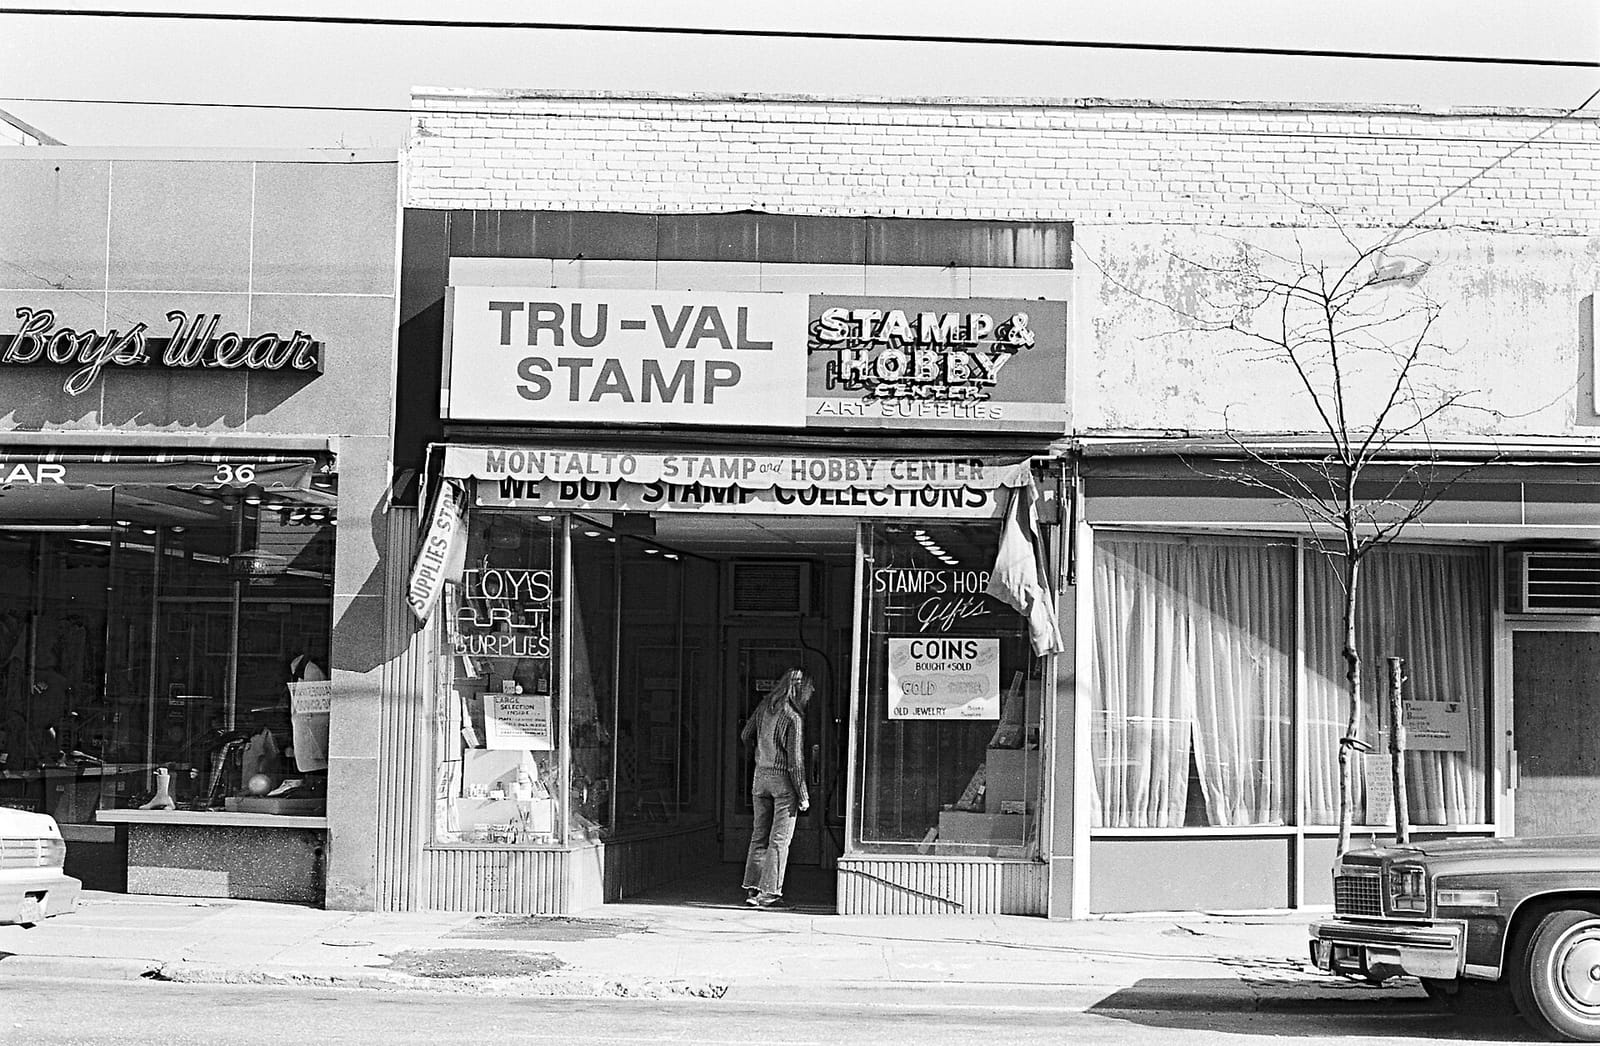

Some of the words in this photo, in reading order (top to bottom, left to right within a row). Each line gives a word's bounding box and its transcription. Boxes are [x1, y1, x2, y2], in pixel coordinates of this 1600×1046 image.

[819, 308, 994, 347] STAMP
[1007, 312, 1035, 349] &
[2, 307, 150, 395] Boys
[166, 310, 316, 369] Wear
[516, 357, 742, 404] STAMP
[839, 350, 1011, 386] HOBBY
[873, 383, 988, 399] CENTER
[816, 401, 870, 416] ART
[881, 401, 1002, 420] SUPPLIES
[0, 463, 66, 484] AR
[213, 464, 256, 484] 36
[486, 450, 638, 475] MONTALTO
[663, 457, 756, 481] STAMP
[759, 459, 784, 474] and
[791, 459, 878, 481] HOBBY
[891, 459, 985, 481] CENTER
[499, 479, 541, 499] WE
[560, 480, 624, 501] BUY
[642, 482, 756, 504] STAMP
[775, 487, 988, 508] COLLECTIONS
[408, 535, 448, 610] SUPPLIES
[464, 570, 551, 601] TOYS
[875, 569, 947, 593] STAMPS
[917, 596, 991, 632] Gifts
[910, 640, 978, 660] COINS
[915, 662, 945, 671] BOUGHT
[952, 662, 972, 671] SOLD
[901, 680, 937, 696] GOLD
[893, 706, 909, 716] OLD
[912, 707, 947, 716] JEWELRY
